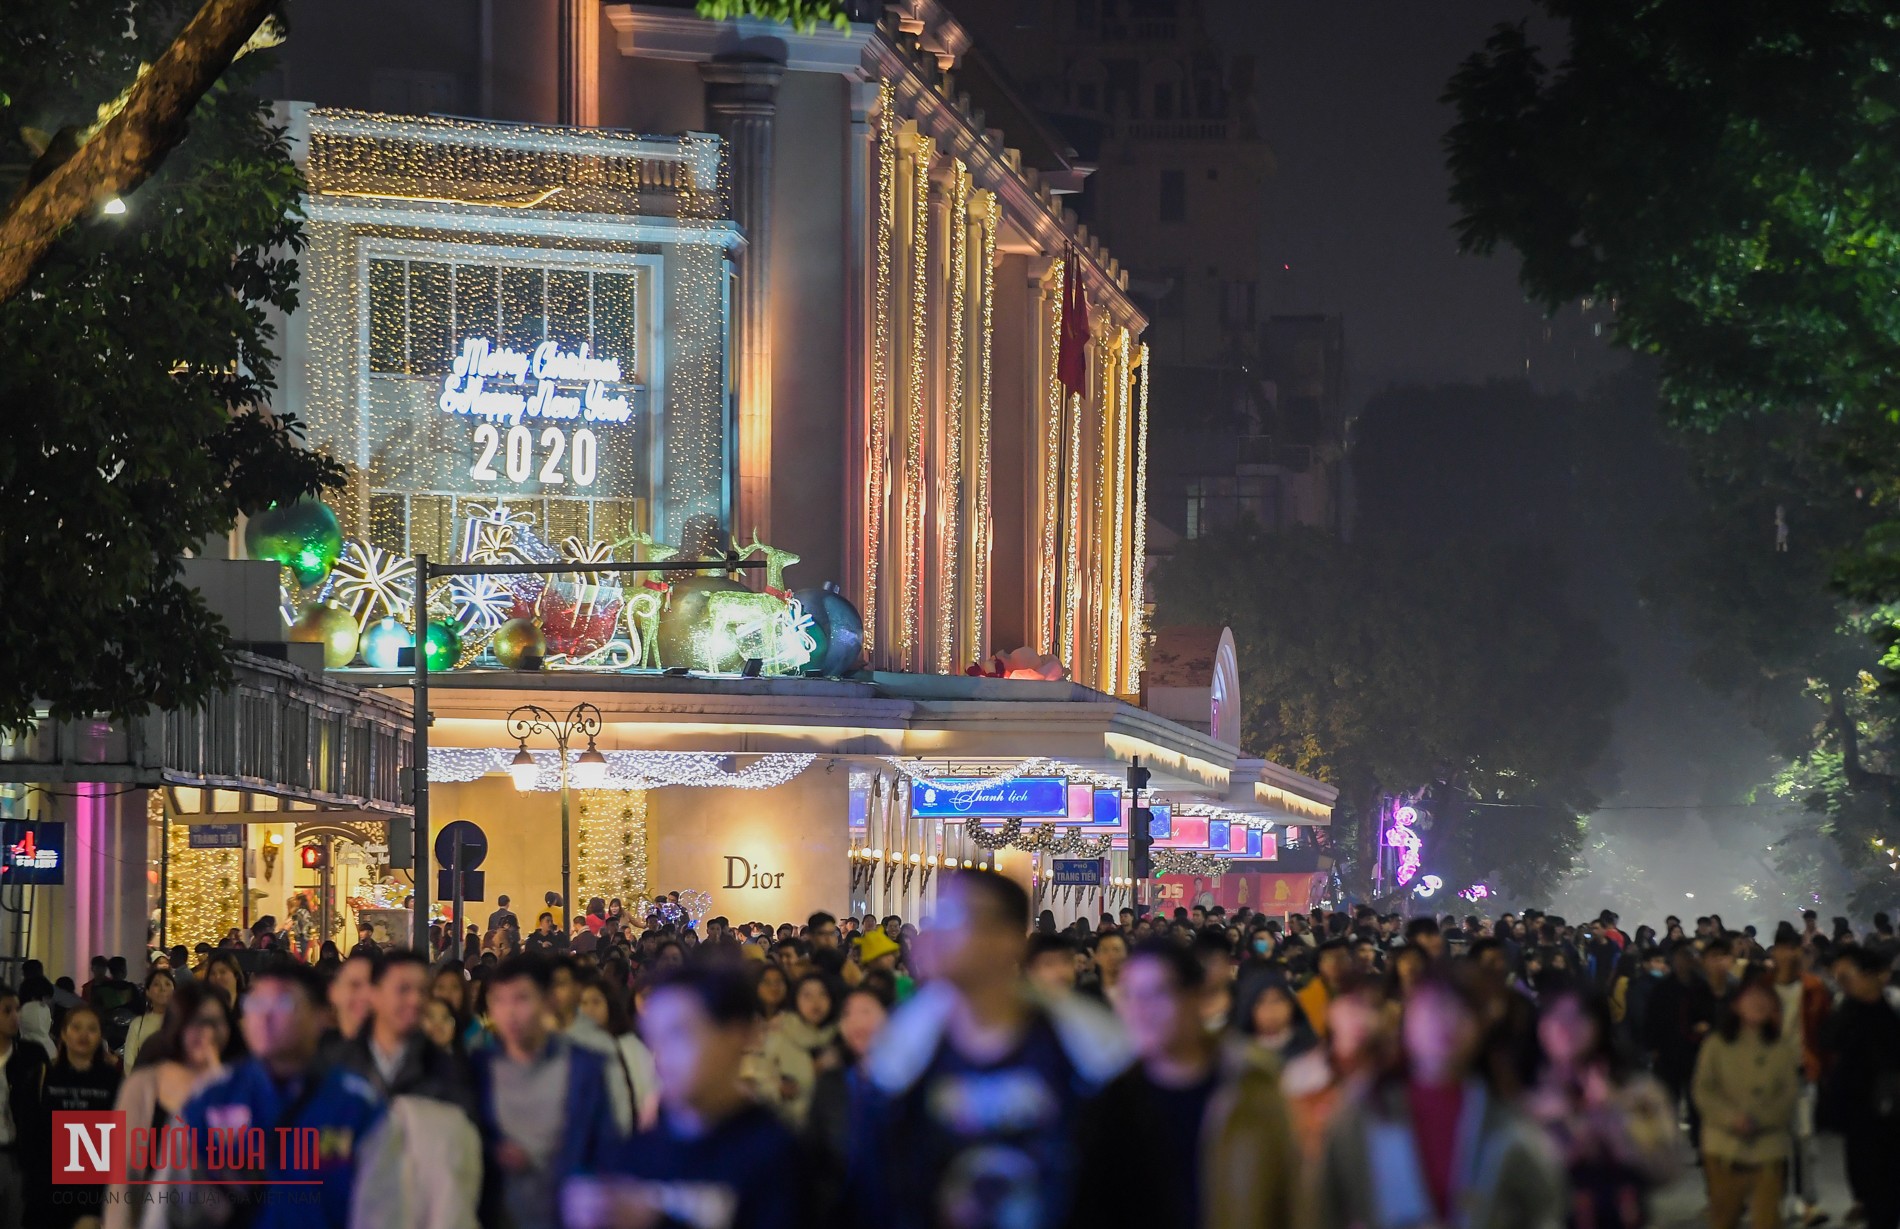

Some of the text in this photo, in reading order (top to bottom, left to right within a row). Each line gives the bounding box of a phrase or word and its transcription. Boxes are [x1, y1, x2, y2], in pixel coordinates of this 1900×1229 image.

[527, 380, 581, 419] New
[584, 380, 632, 422] Year
[473, 424, 597, 486] 2020
[723, 856, 784, 889] Dior
[1056, 871, 1079, 881] TRÀNG
